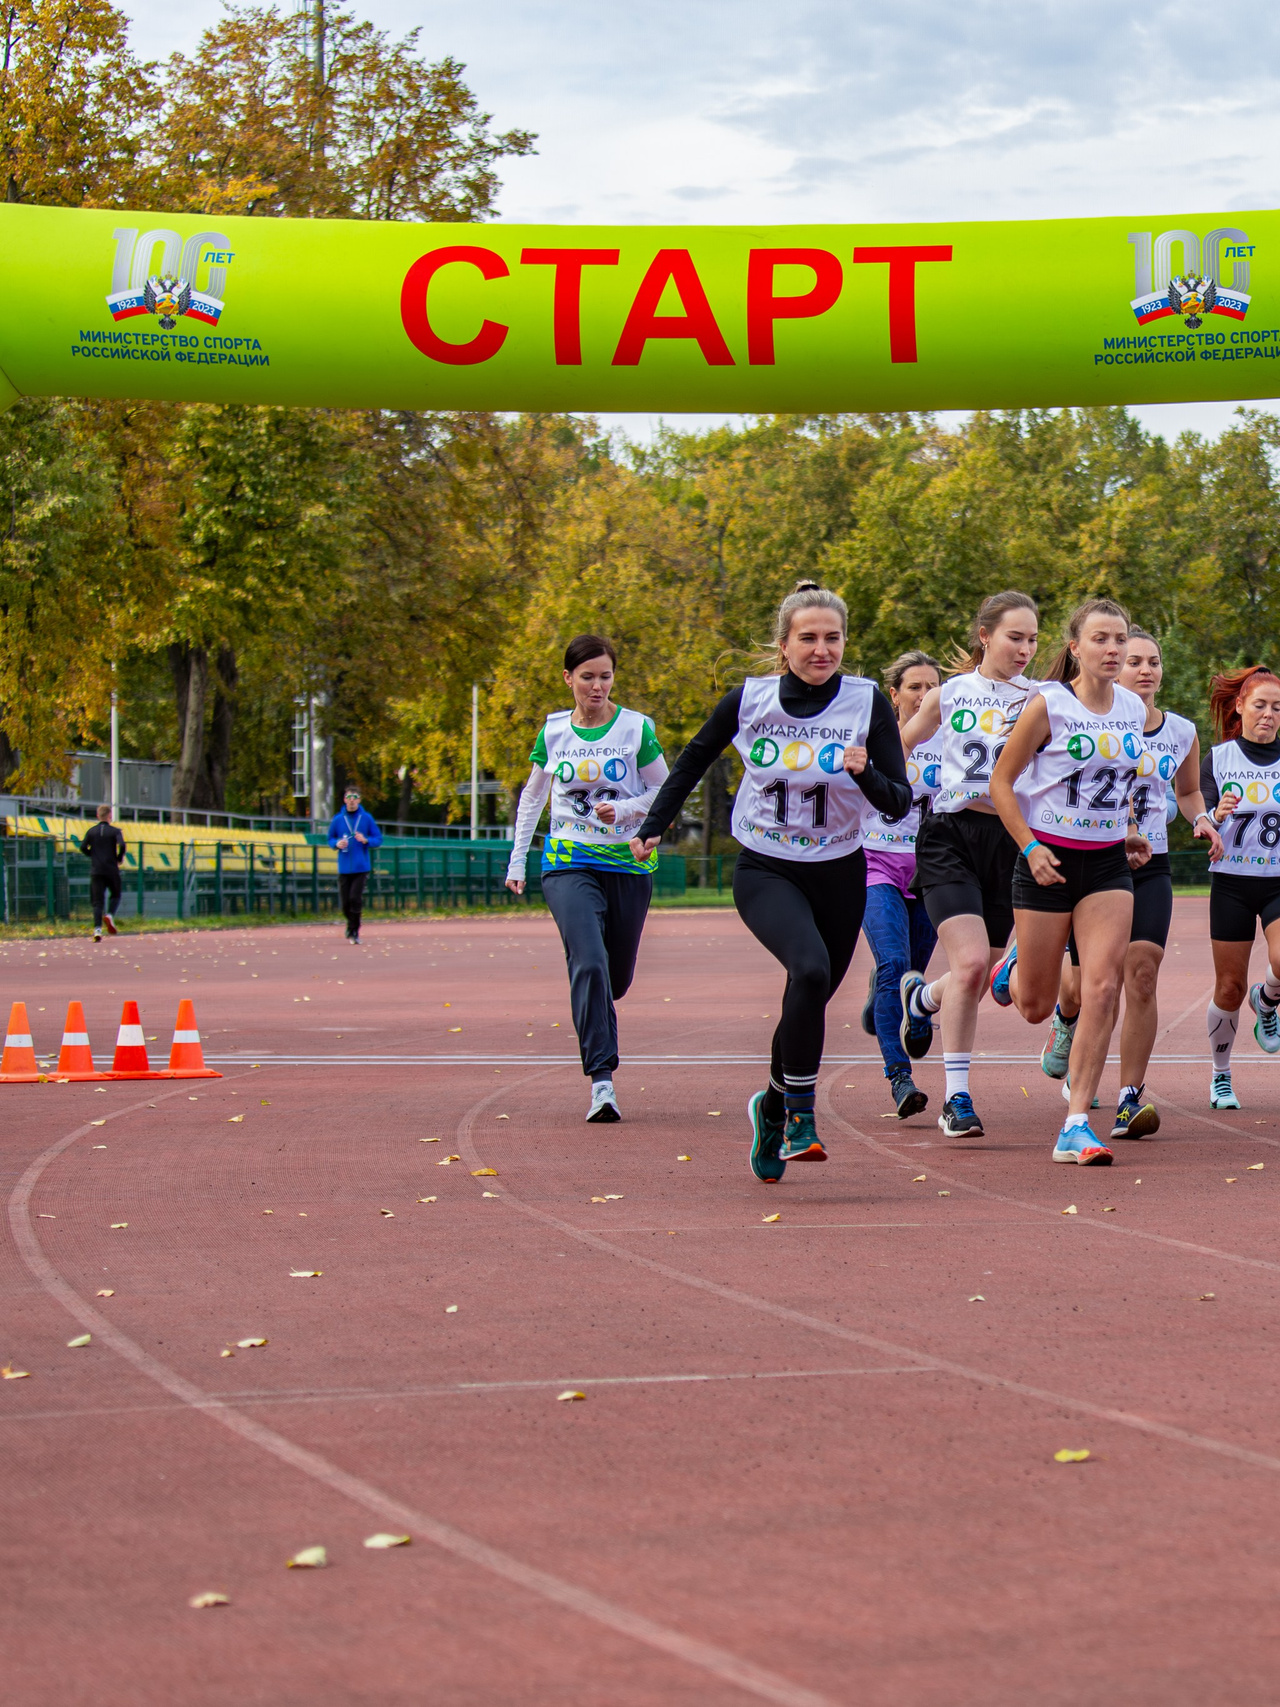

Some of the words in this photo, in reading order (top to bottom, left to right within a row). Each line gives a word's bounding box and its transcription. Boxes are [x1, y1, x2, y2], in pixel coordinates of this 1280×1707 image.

[111, 228, 231, 300] 100
[203, 252, 235, 263] ЛЕТ
[1127, 227, 1250, 299] 100
[1224, 246, 1256, 258] ЛЕТ
[116, 298, 137, 310] 1923
[192, 301, 216, 316] 2023
[400, 245, 953, 366] СТАРТ
[1141, 301, 1163, 314] 1923
[1218, 297, 1242, 311] 2023
[79, 330, 199, 348] МИНИСТЕРСТВО
[203, 336, 262, 351] СПОРТА
[1103, 333, 1226, 350] МИНИСТЕРСТВО
[71, 345, 171, 362] РОССИЙСКОЙ
[175, 351, 270, 367] ФЕДЕРАЦИИ
[1094, 348, 1196, 366] РОССИЙСКОЙ
[751, 723, 853, 741] VMARAFONE
[1064, 721, 1139, 733] VMARAFONE
[555, 747, 629, 760] VMARAFONE
[763, 778, 829, 829] 11
[558, 819, 642, 835] VMARAFONE.CLUB
[748, 823, 860, 847] VMARAFONE.CLUB
